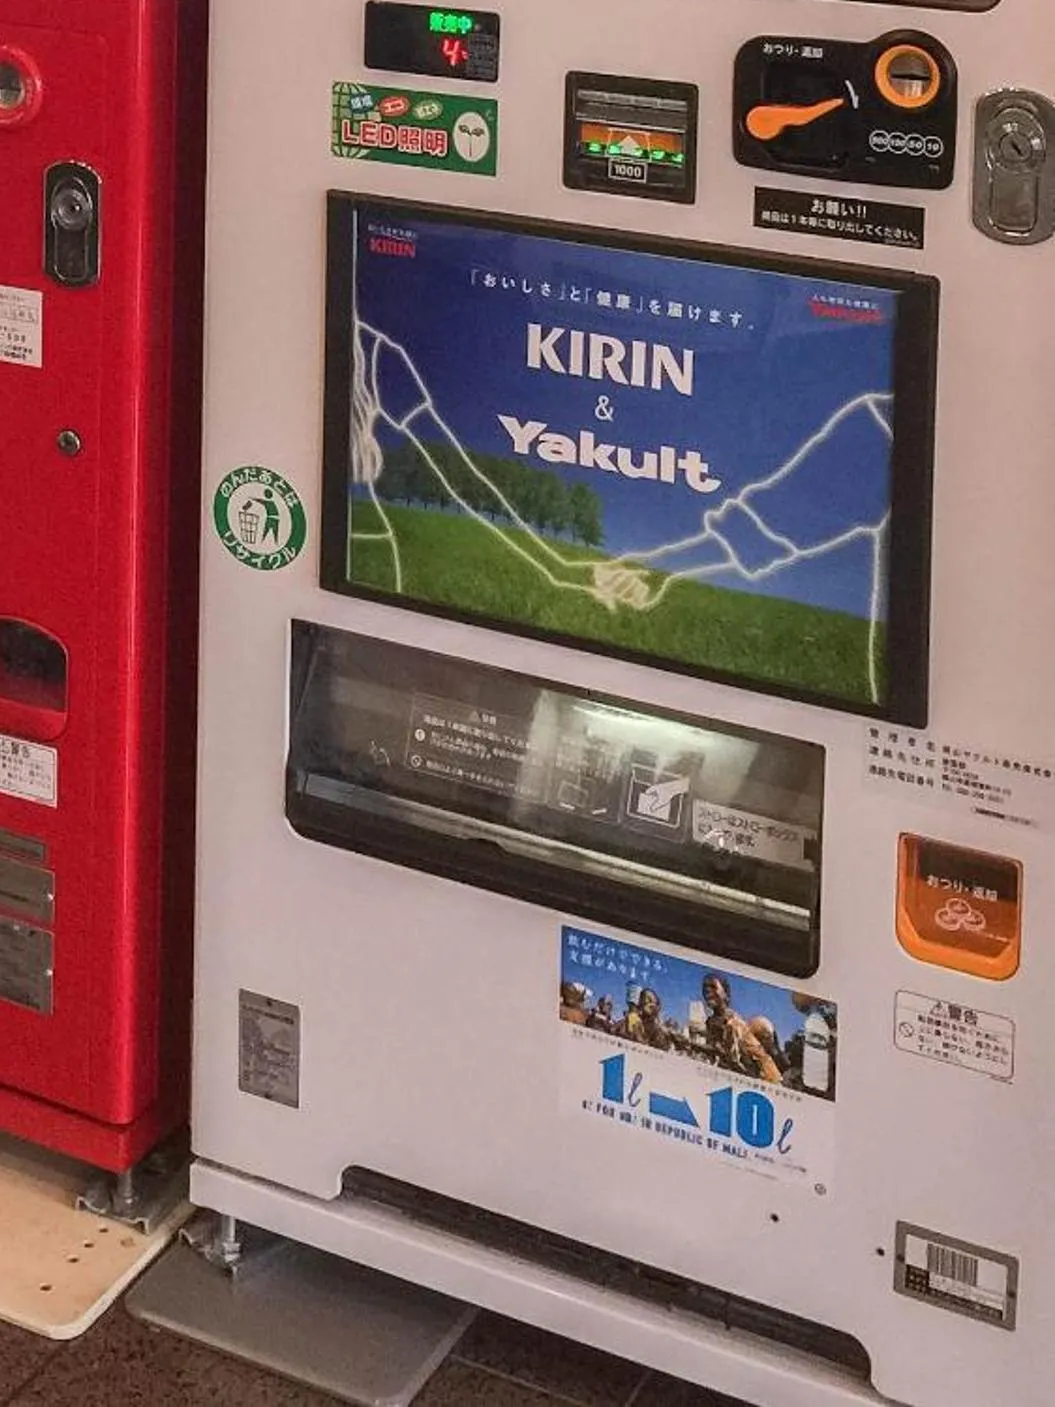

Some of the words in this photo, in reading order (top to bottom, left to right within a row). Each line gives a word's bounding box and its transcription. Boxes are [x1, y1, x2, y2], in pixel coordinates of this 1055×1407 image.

[342, 108, 449, 159] LED照明
[525, 322, 695, 397] KIRIN
[594, 395, 615, 422] &
[497, 413, 723, 494] Yakult
[655, 1121, 703, 1146] REPUBLIC
